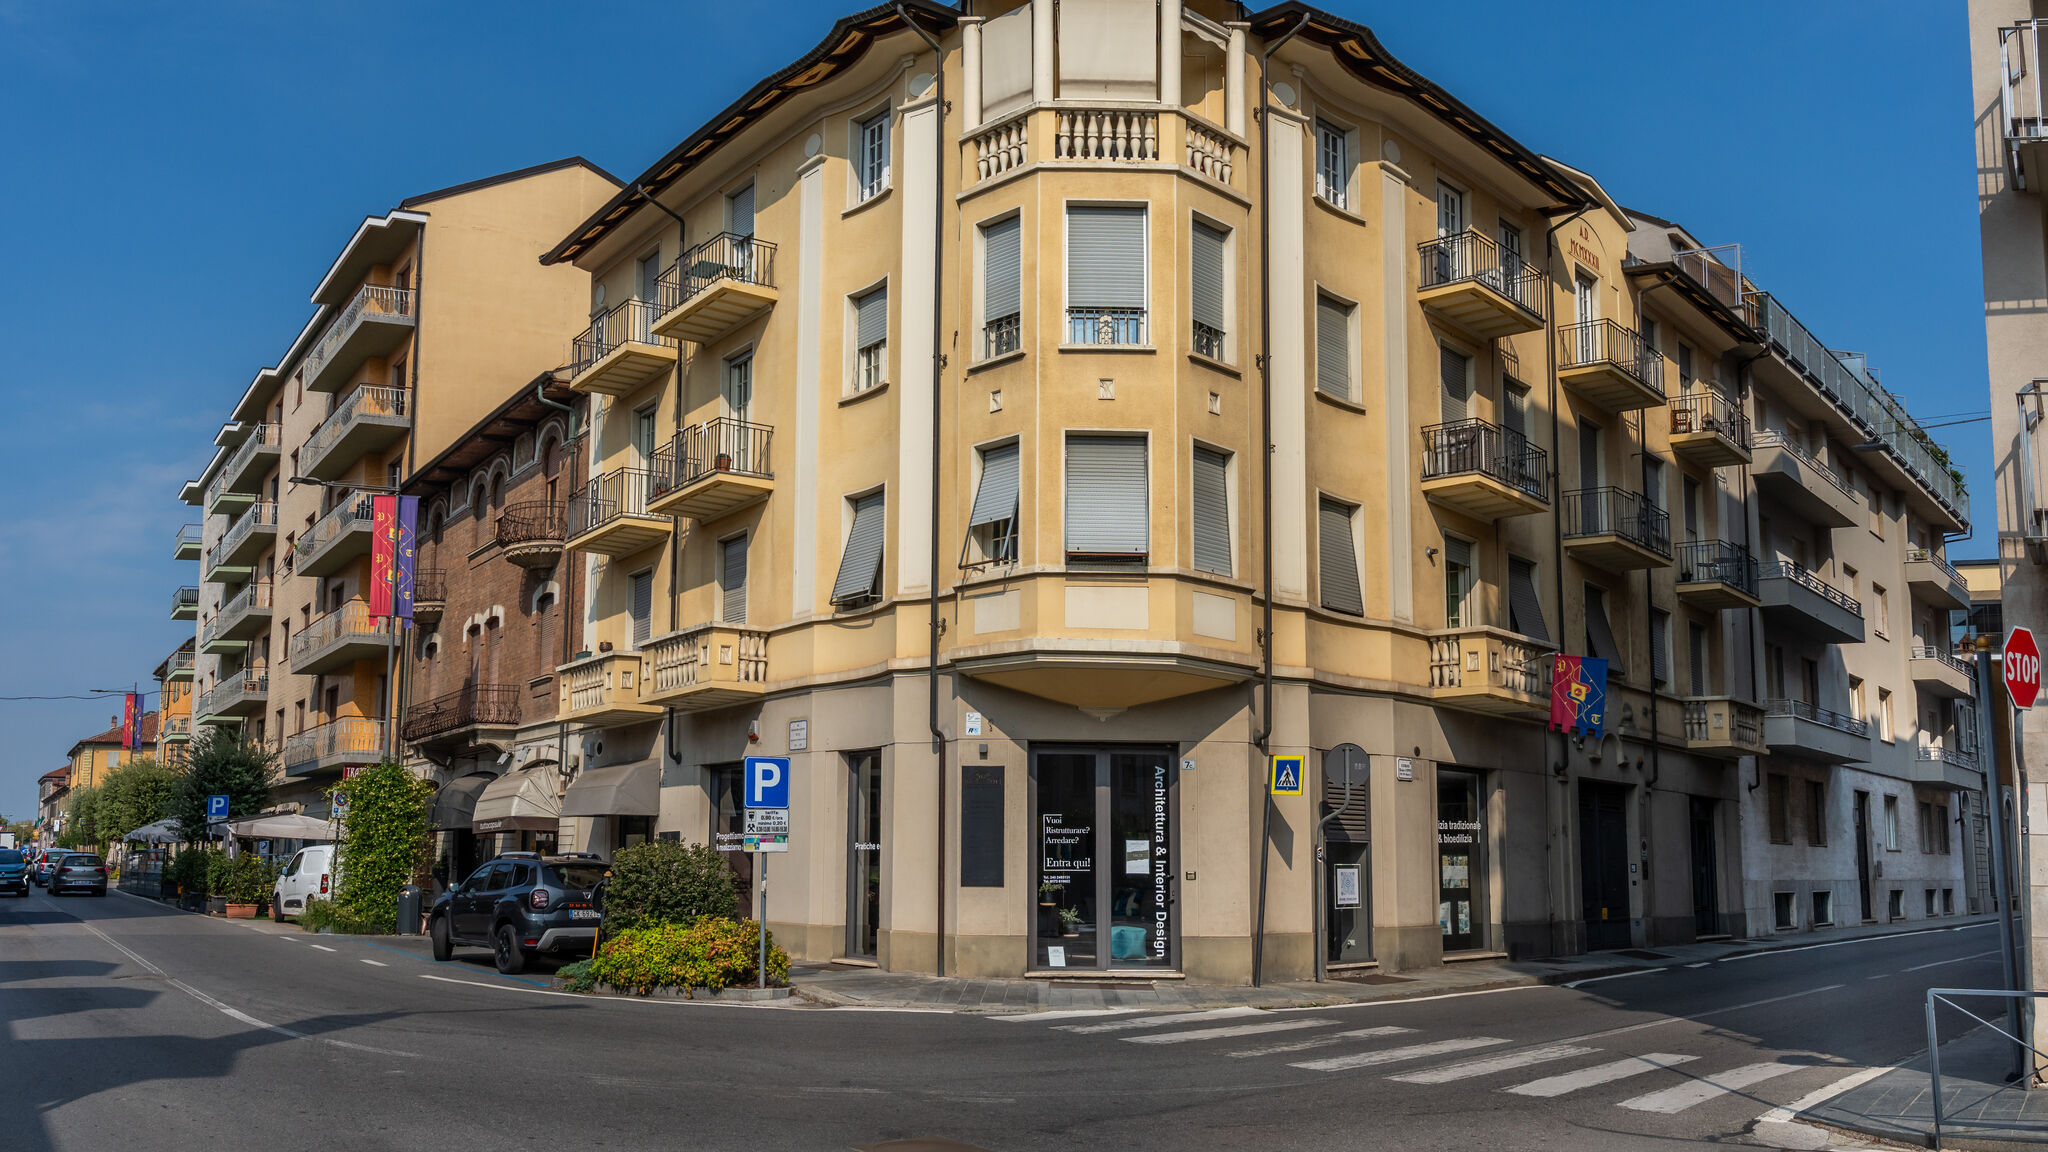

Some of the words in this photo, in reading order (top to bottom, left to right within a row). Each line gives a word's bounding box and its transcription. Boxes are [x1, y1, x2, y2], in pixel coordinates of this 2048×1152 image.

[2007, 651, 2039, 684] STOP
[754, 762, 781, 802] P
[211, 797, 225, 814] P
[1154, 765, 1166, 843] Architettura
[1045, 816, 1062, 824] Vuoi
[1449, 820, 1481, 830] tradizionale
[1045, 826, 1091, 834] Ristrutturare?
[716, 832, 744, 842] Progettiamo
[1045, 836, 1080, 844] Arredare?
[1443, 834, 1472, 843] bioedilizia
[855, 842, 876, 850] Pratiche
[1155, 846, 1166, 856] &
[1046, 857, 1071, 867] Entra
[1073, 857, 1091, 869] qui!
[1155, 860, 1167, 908] Interior
[1154, 911, 1167, 958] Design
